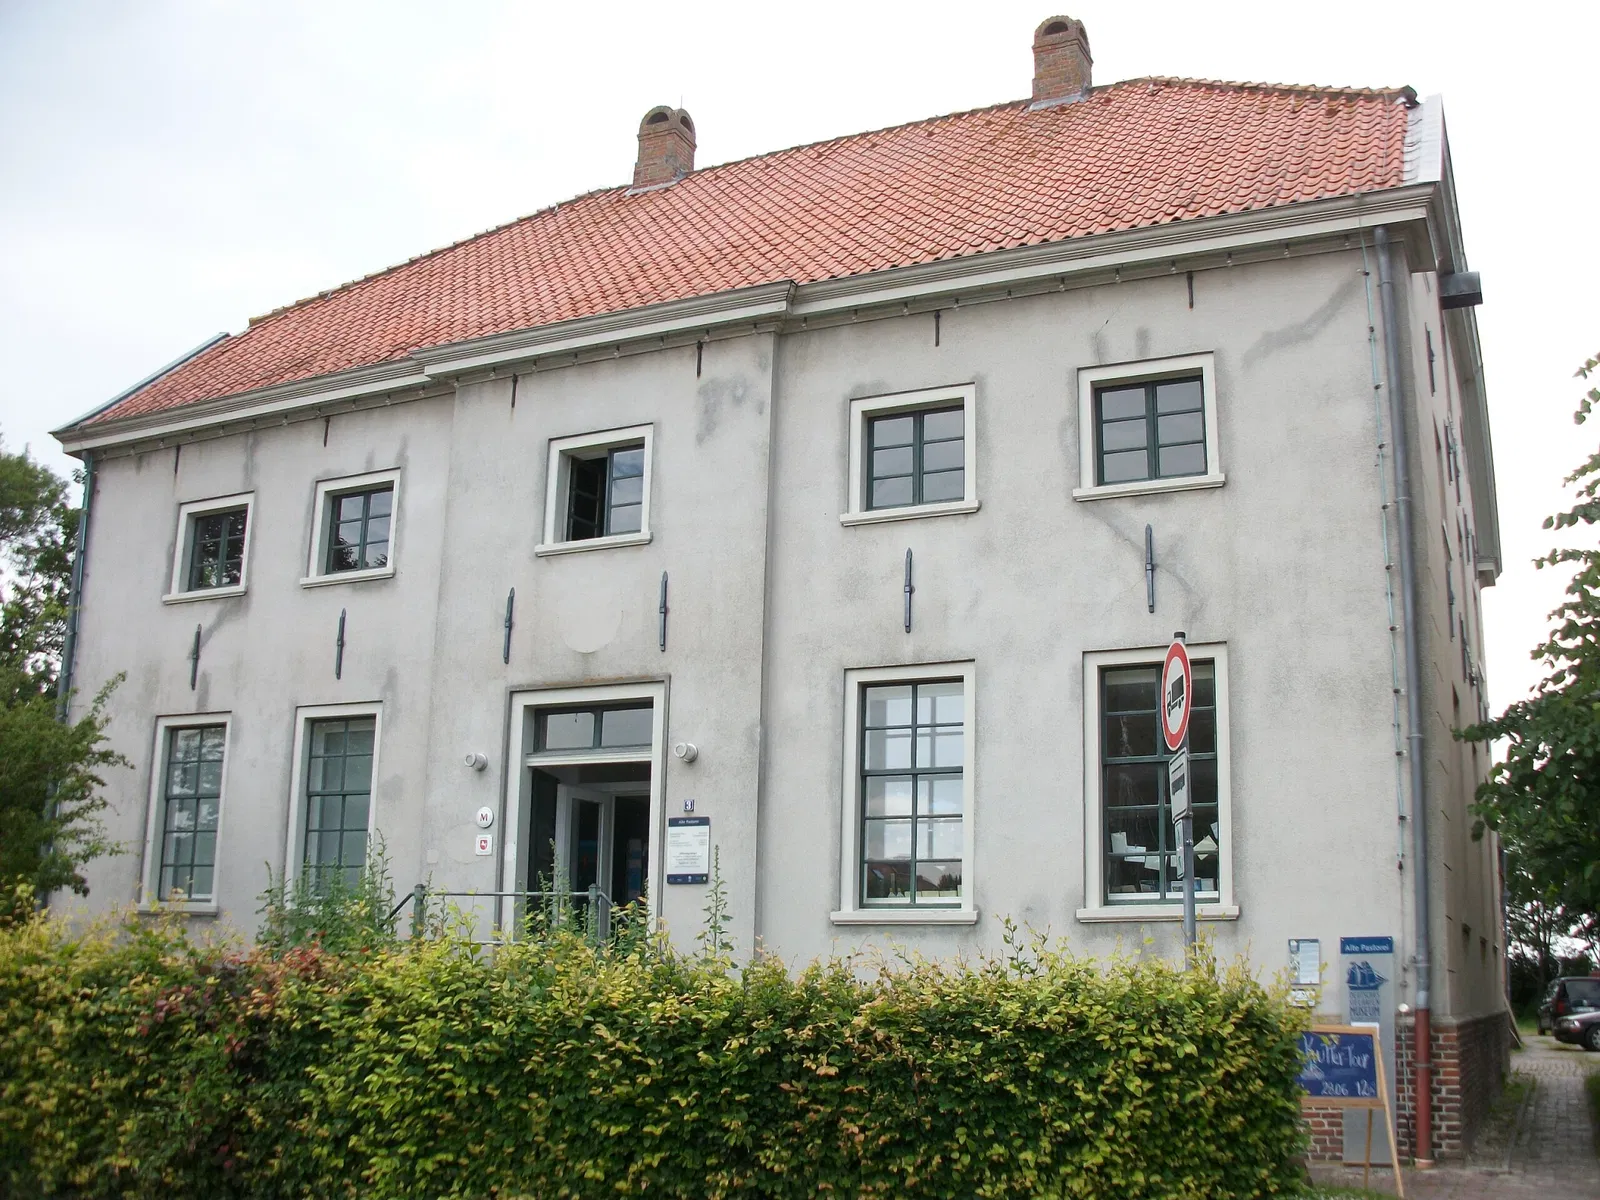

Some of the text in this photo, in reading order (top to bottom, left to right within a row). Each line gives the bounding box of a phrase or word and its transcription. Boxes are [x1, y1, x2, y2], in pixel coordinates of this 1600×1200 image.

[686, 800, 692, 810] 3
[480, 813, 488, 821] M
[1361, 943, 1390, 951] Pastorei
[1349, 1006, 1380, 1017] MUSEUM
